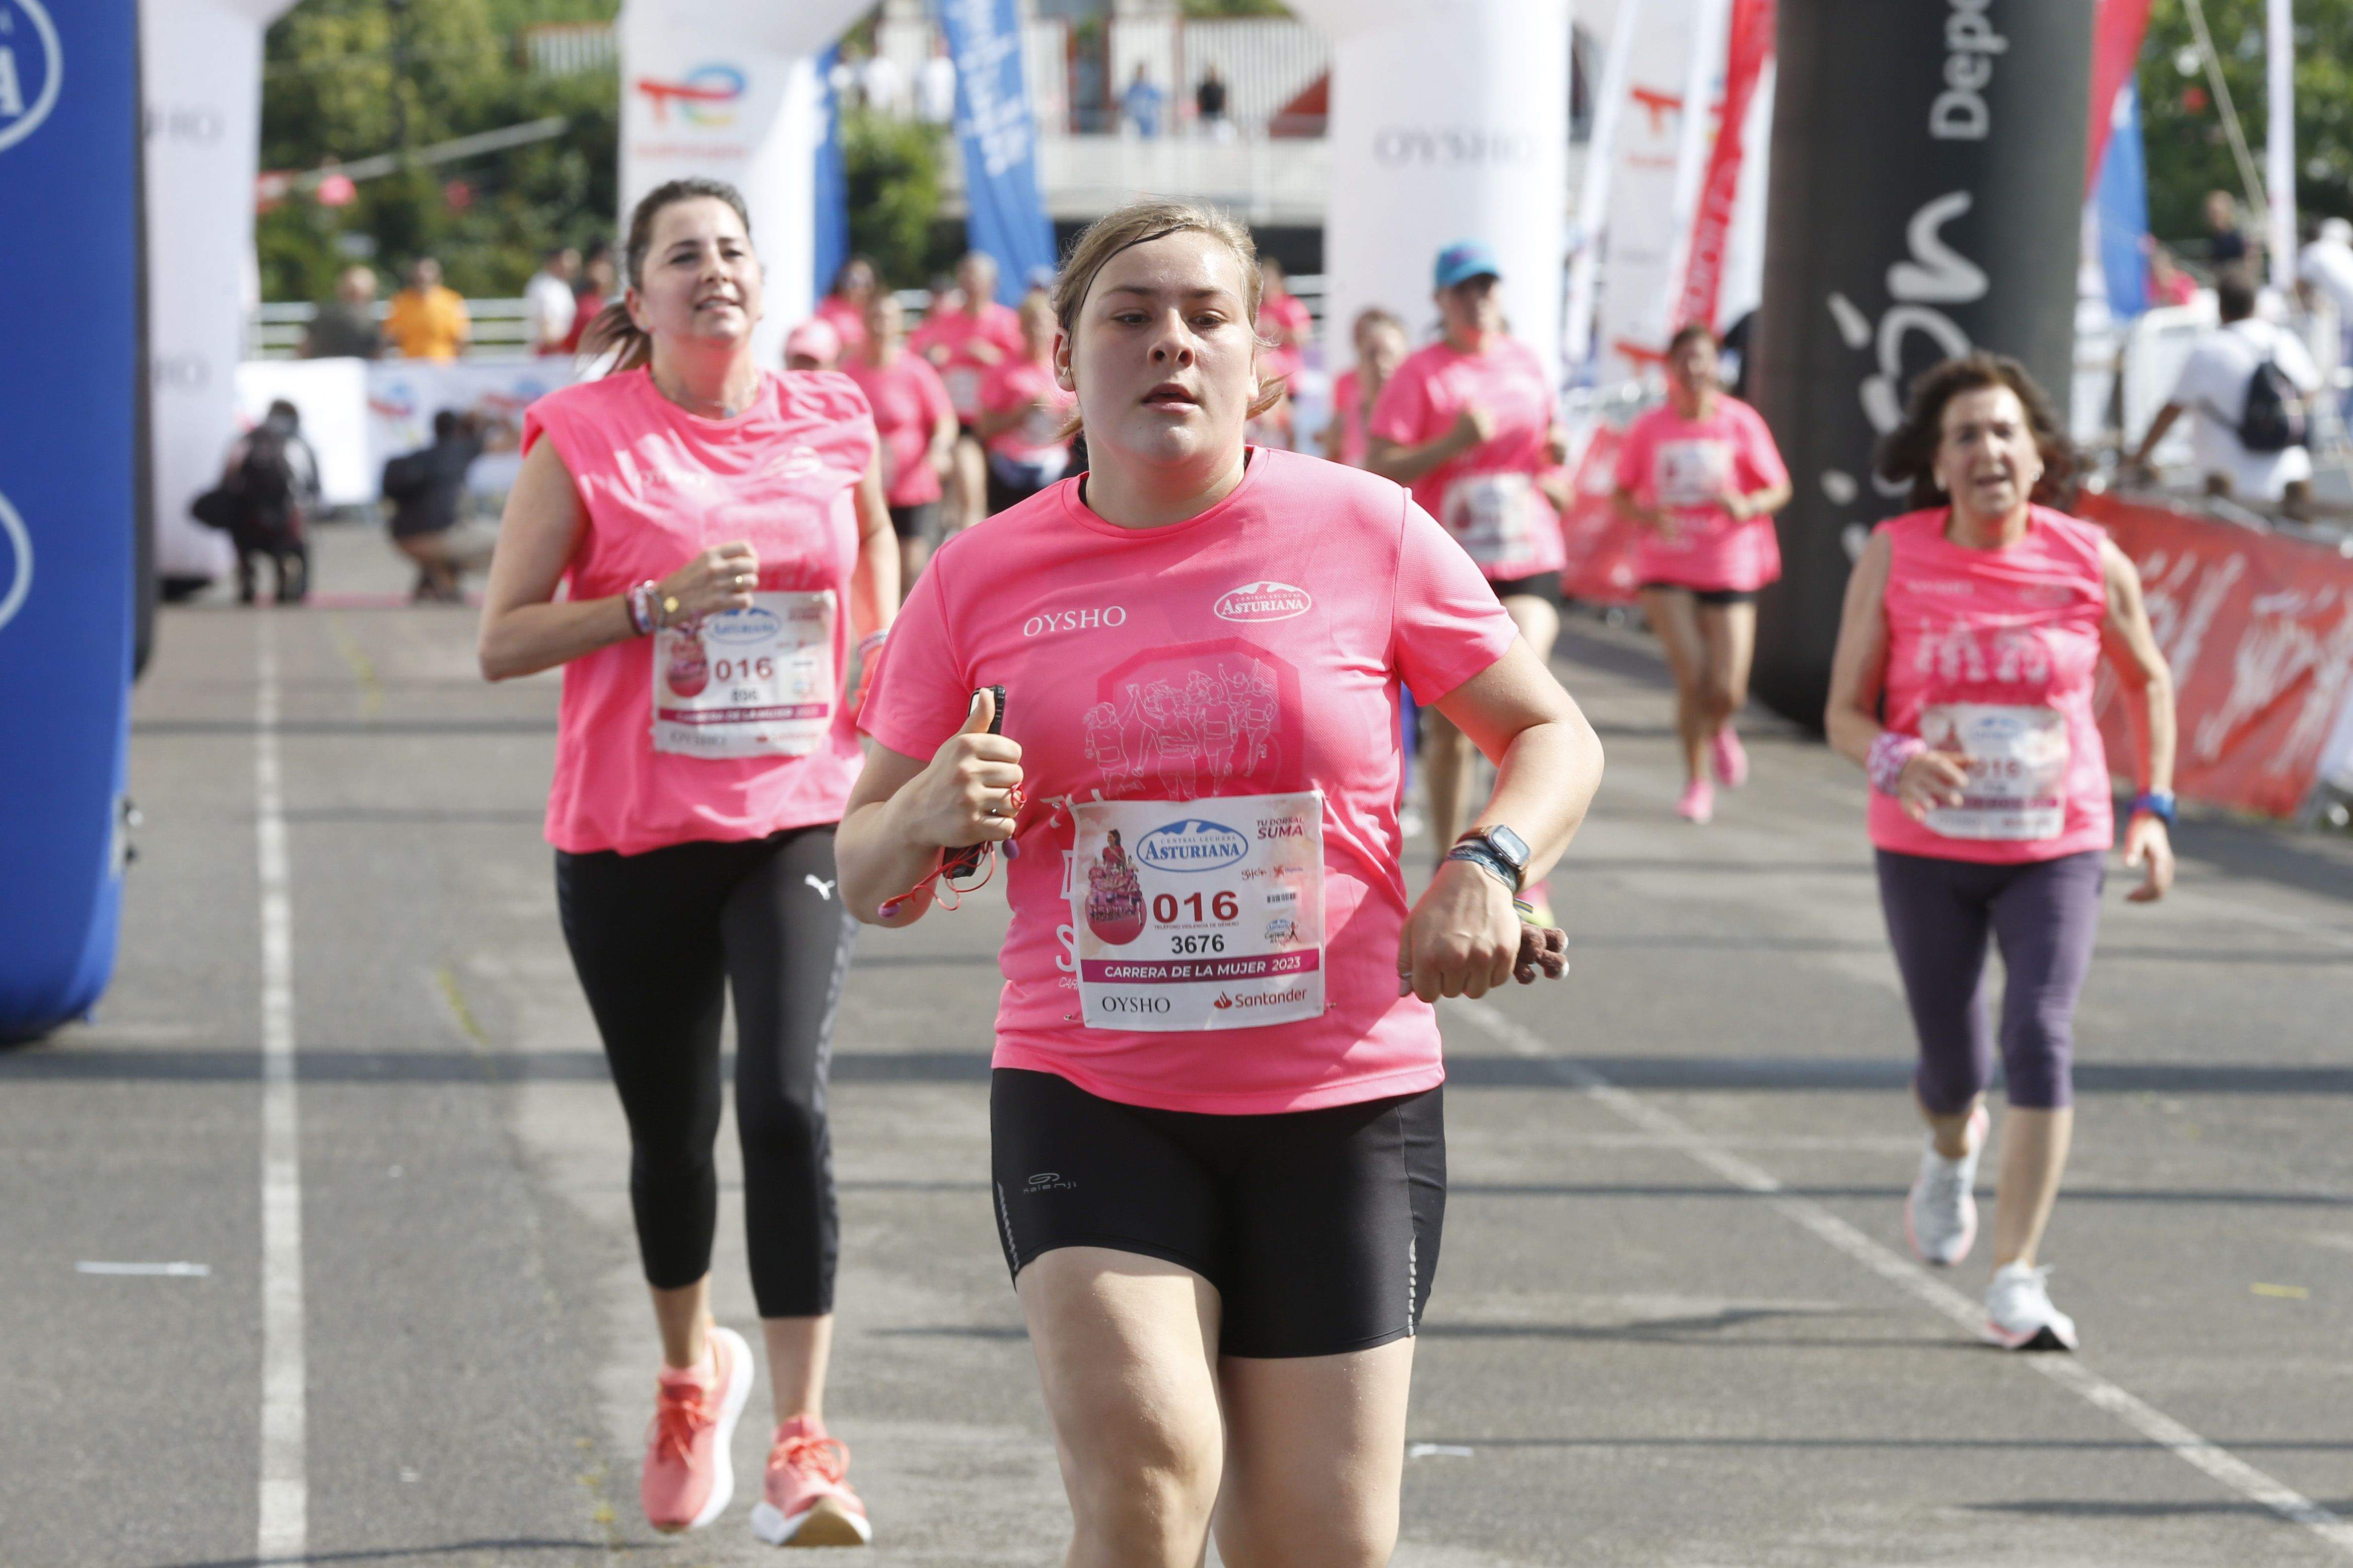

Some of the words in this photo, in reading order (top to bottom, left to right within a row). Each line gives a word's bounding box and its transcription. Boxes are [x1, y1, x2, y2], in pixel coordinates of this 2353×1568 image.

[1221, 599, 1305, 615] ASTURIANA
[1023, 606, 1126, 637] OYSHO
[715, 657, 773, 682] 016
[1270, 816, 1303, 826] DORSAL
[1200, 835, 1235, 843] LECHERA
[1258, 825, 1303, 839] SUMA
[1145, 840, 1240, 860] ASTURIANA
[1153, 890, 1238, 923] 016
[1171, 934, 1224, 954] 3676
[1105, 966, 1167, 978] CARRERA
[1171, 966, 1191, 977] DE
[1195, 965, 1213, 977] LA
[1217, 961, 1266, 976] MUJER
[1272, 956, 1301, 972] 2023
[1102, 996, 1171, 1014] OYSHO
[1235, 988, 1307, 1008] Santander
